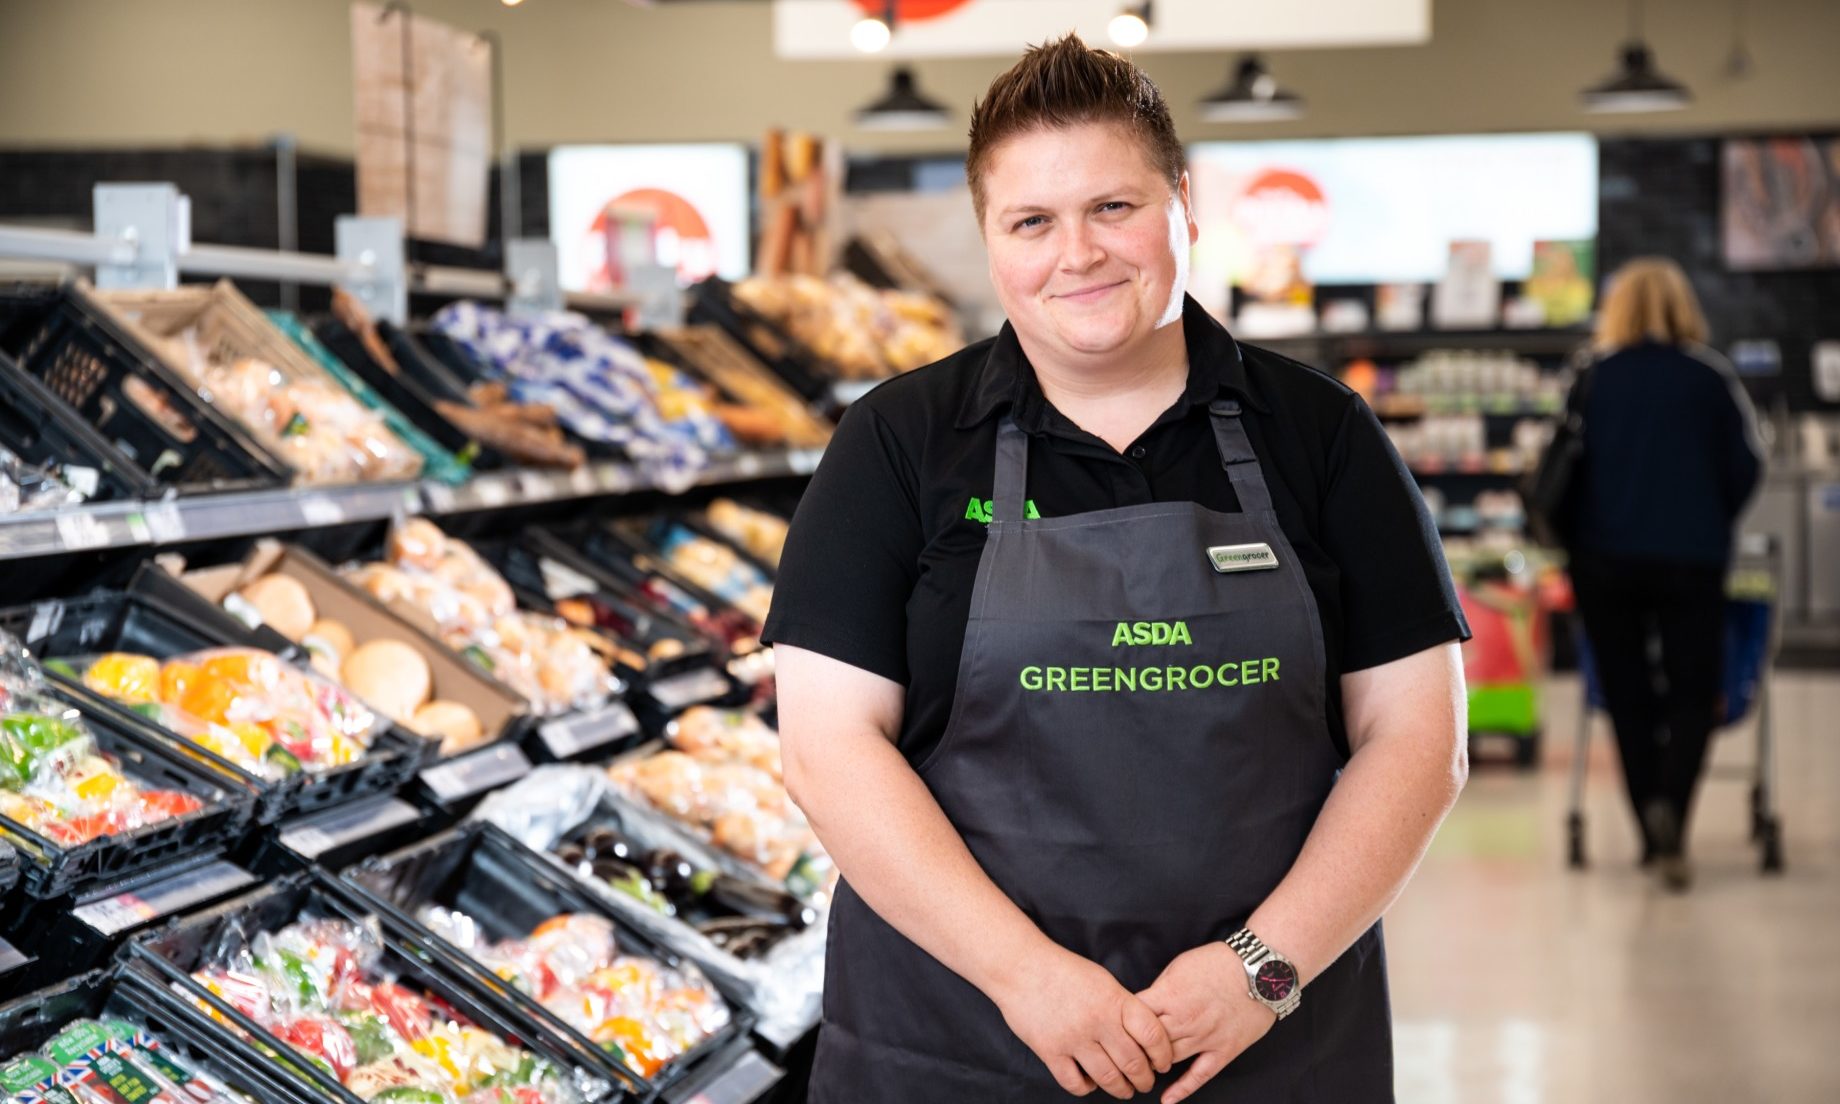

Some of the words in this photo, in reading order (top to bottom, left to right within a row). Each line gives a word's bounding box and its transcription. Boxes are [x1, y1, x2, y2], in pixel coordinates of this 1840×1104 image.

[965, 497, 1041, 523] ASA
[1215, 552, 1269, 563] Greengrocer
[1112, 620, 1192, 646] ASDA
[1020, 657, 1280, 692] GREENGROCER
